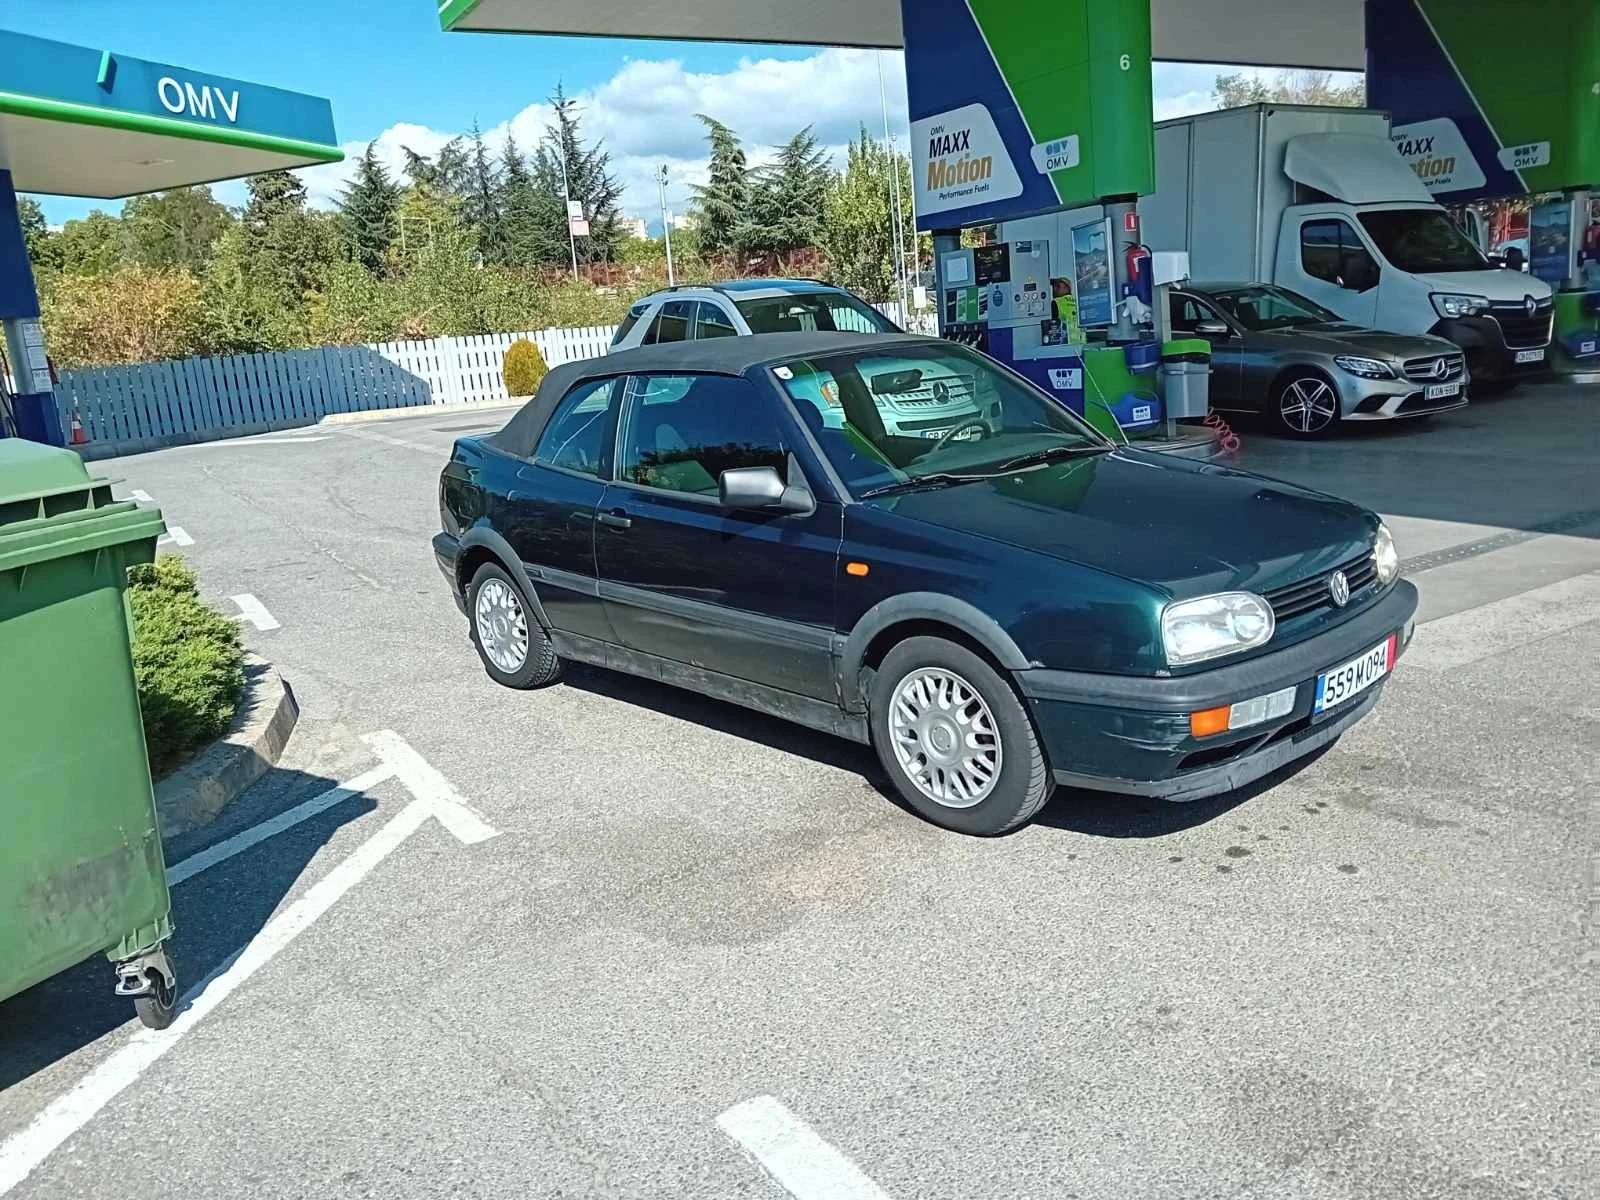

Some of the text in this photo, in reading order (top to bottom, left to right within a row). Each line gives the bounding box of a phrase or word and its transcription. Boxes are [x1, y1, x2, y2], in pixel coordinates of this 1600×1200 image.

[1119, 54, 1130, 71] 6
[158, 76, 239, 123] OMV
[930, 125, 945, 137] OMV
[929, 128, 971, 159] MAXX
[1046, 156, 1069, 170] OMV
[1409, 154, 1456, 178] tion
[1514, 157, 1539, 168] OMV
[927, 154, 993, 192] Motion
[938, 183, 990, 200] Performance Fuels
